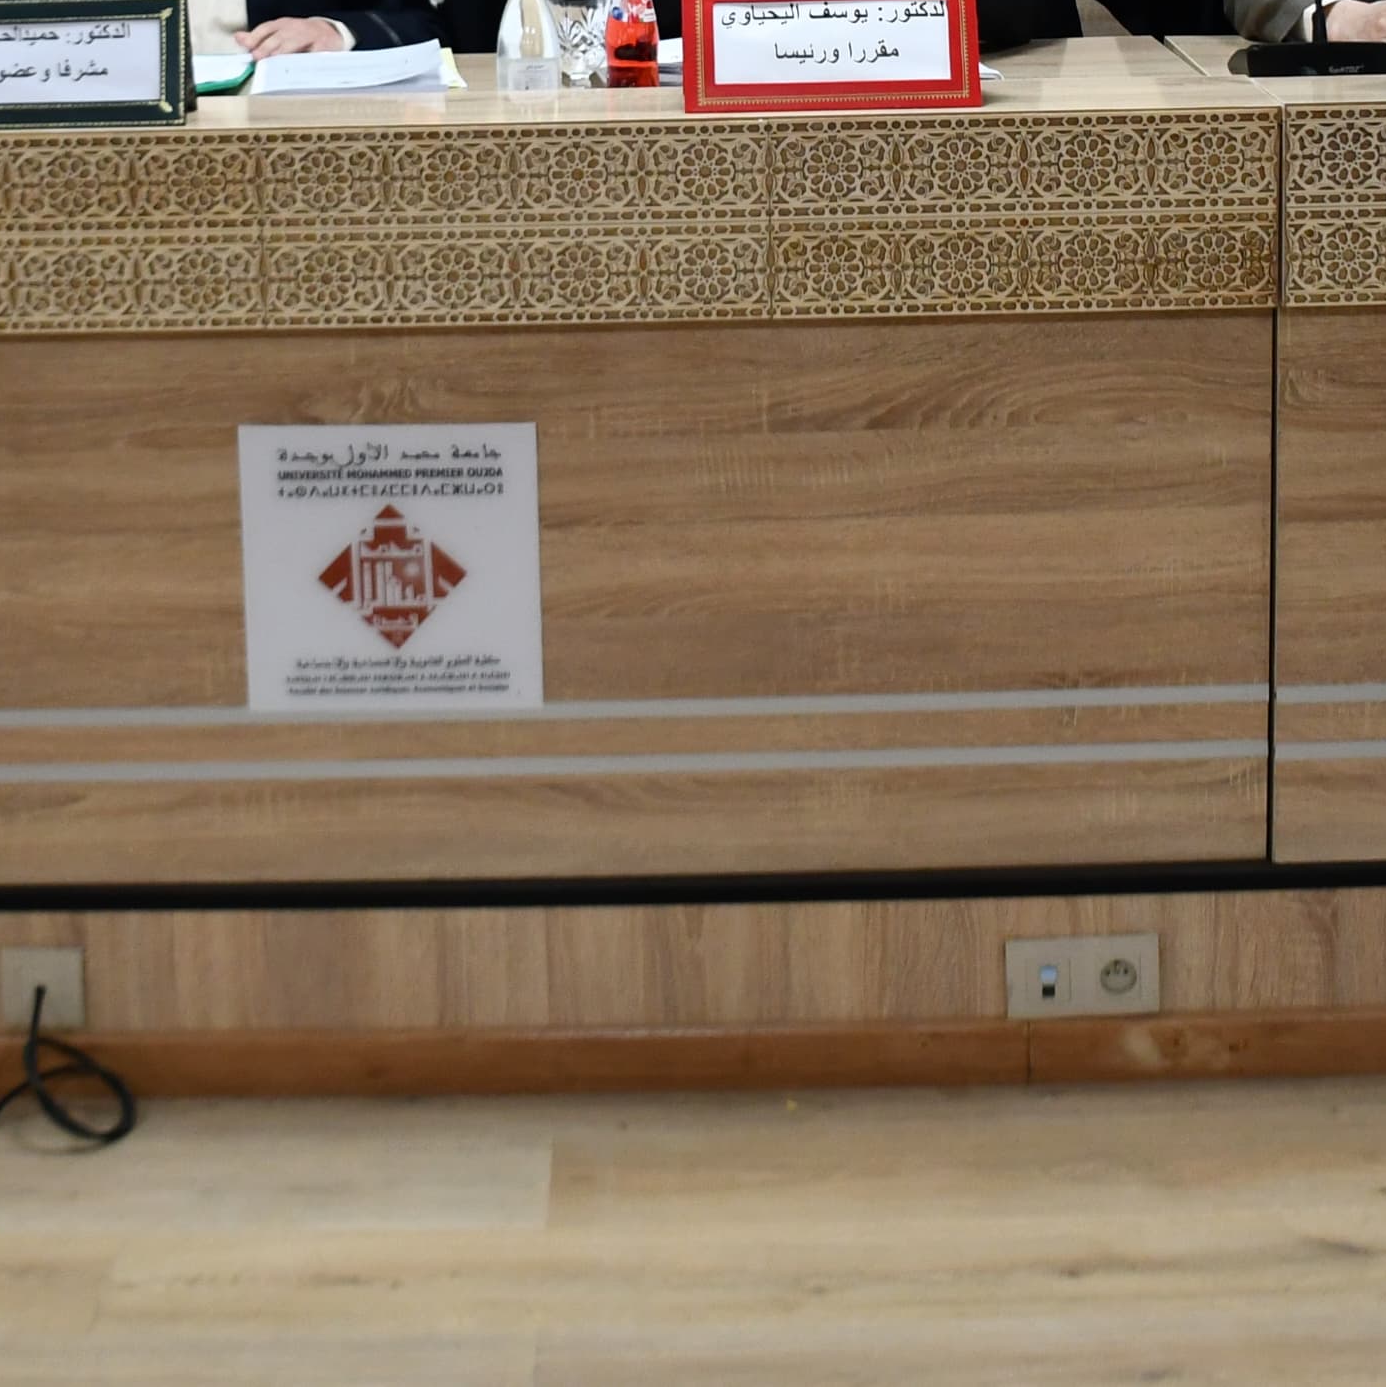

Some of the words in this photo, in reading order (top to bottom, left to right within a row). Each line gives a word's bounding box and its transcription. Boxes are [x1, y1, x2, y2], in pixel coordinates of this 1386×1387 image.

[721, 3, 800, 29] اليحياوي
[809, 2, 869, 24] يوسف
[878, 1, 946, 23] لدكتور:
[848, 39, 900, 64] مقررا
[57, 58, 109, 82] مشرفا
[400, 448, 440, 461] محمد
[451, 442, 502, 460] جامعة
[346, 467, 412, 480] MOHAMMED
[414, 466, 463, 479] PREMIER
[467, 465, 503, 478] OUJDA
